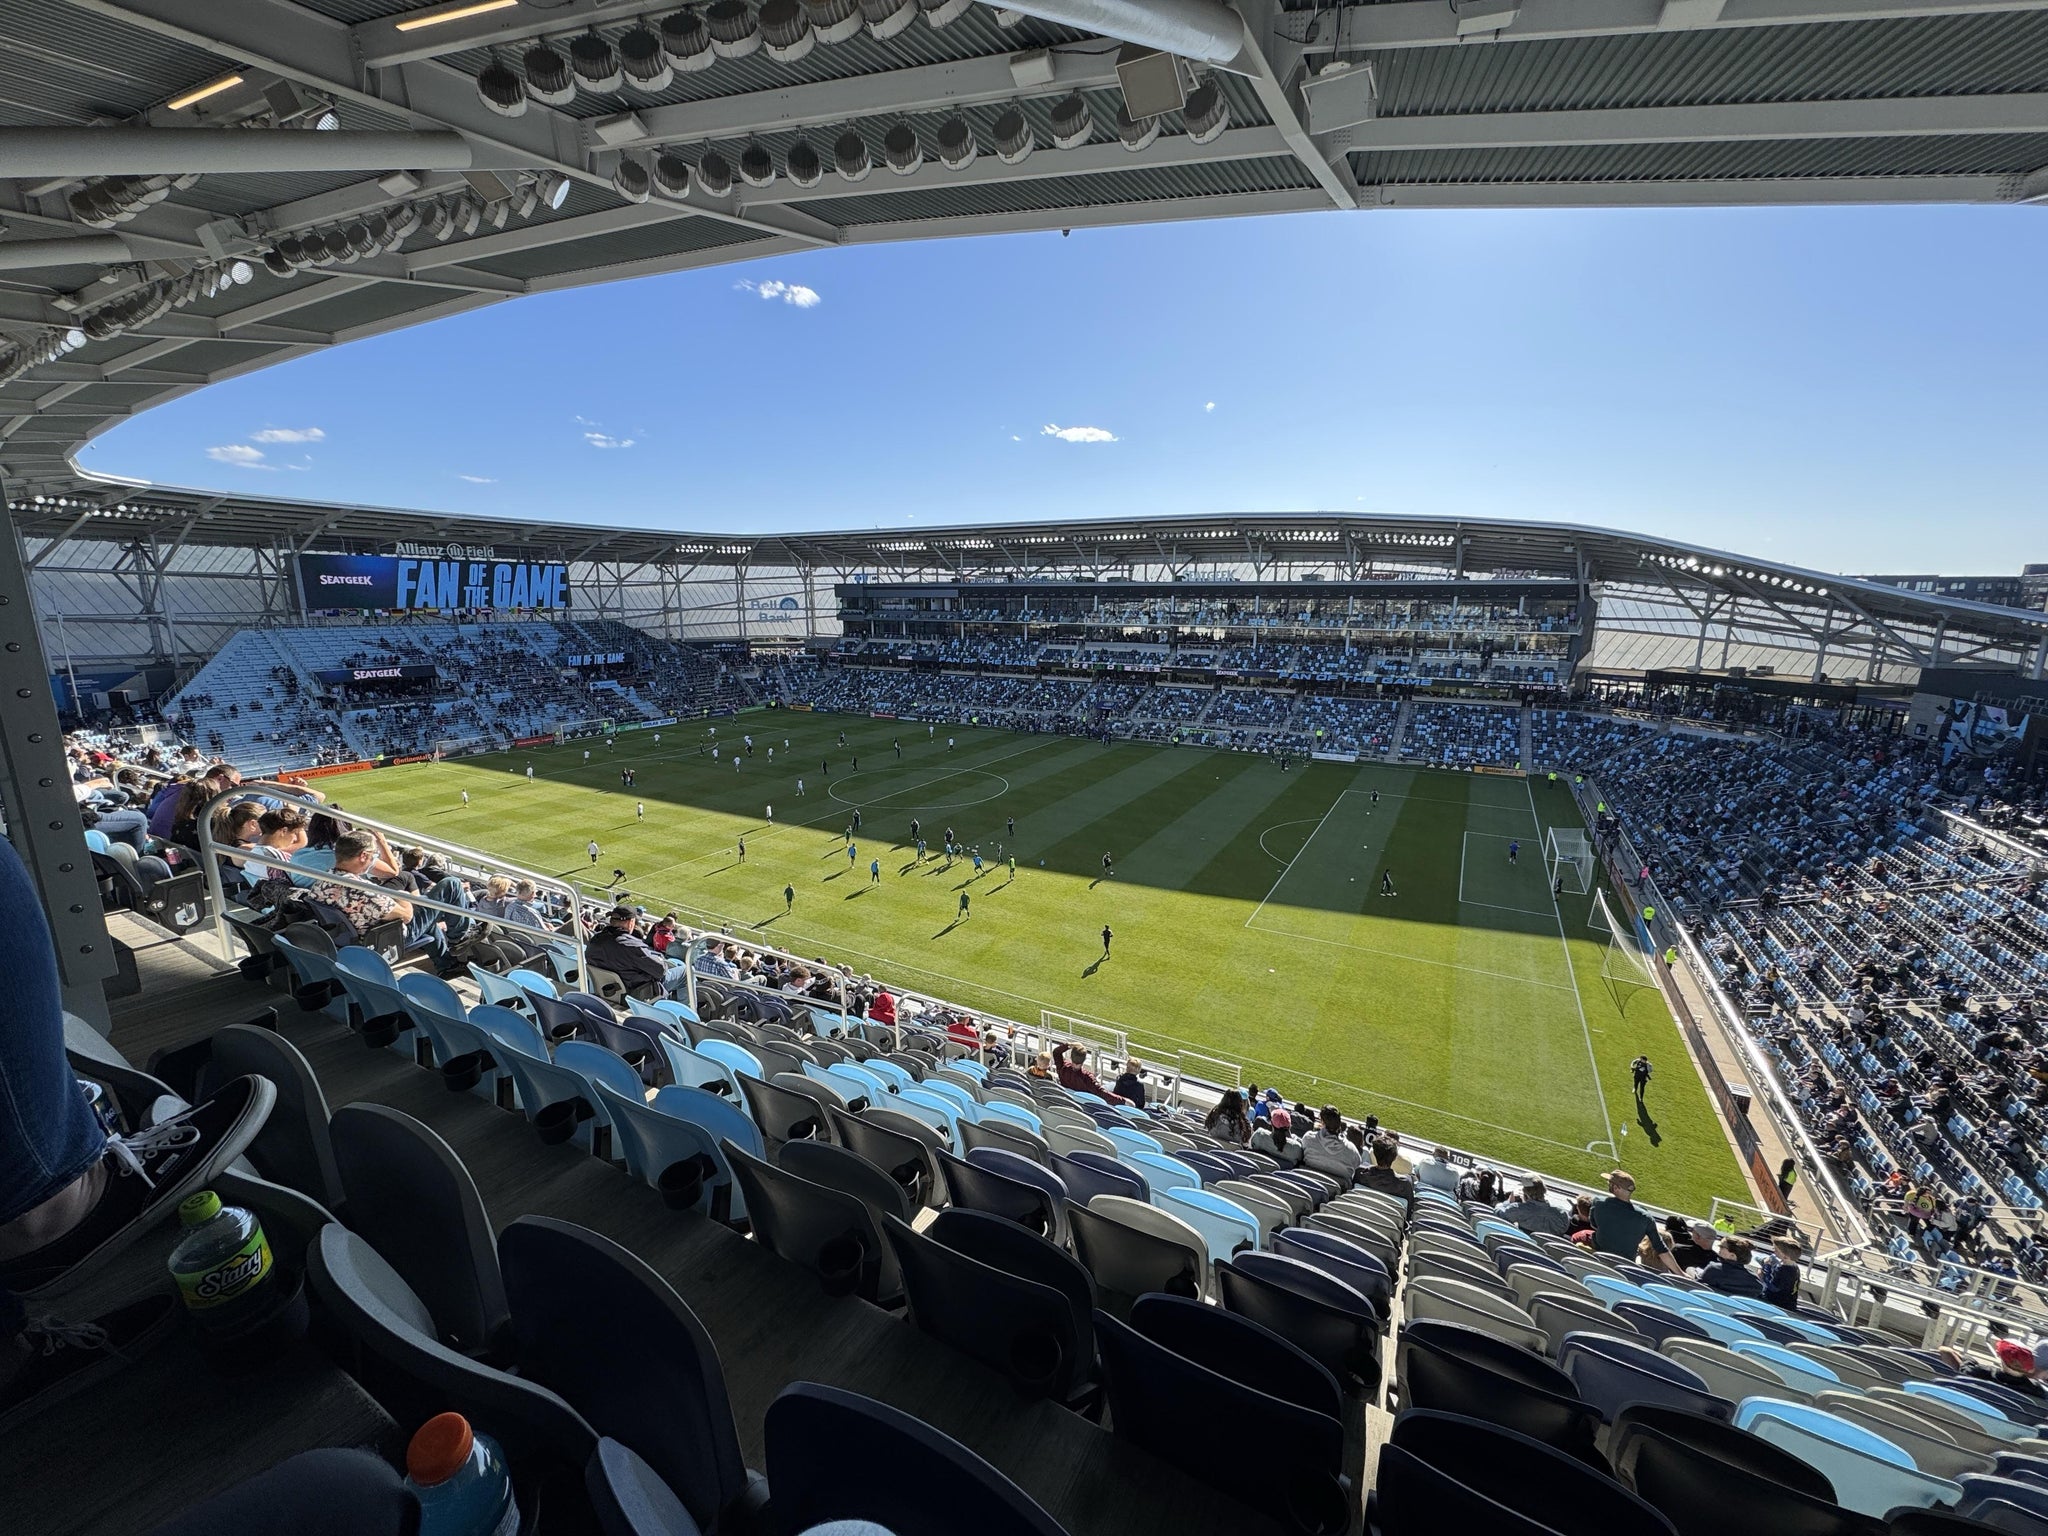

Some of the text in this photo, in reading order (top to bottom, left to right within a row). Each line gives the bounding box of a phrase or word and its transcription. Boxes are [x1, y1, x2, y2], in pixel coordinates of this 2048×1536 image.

[395, 542, 495, 558] Allianz Field
[319, 574, 374, 586] SEATGEEK
[1183, 570, 1237, 582] SEATGEEK
[396, 560, 568, 609] FAN OF THE GAME
[750, 600, 777, 610] Bell
[759, 611, 793, 623] Bank
[568, 652, 625, 666] FAN OF THE GAME
[1005, 659, 1037, 667] GAME
[353, 668, 402, 680] SEATGEEK
[1278, 670, 1433, 686] FAN OF THE GAME
[151, 901, 164, 909] 16
[1452, 1153, 1470, 1167] 109
[198, 1248, 262, 1298] Starry
